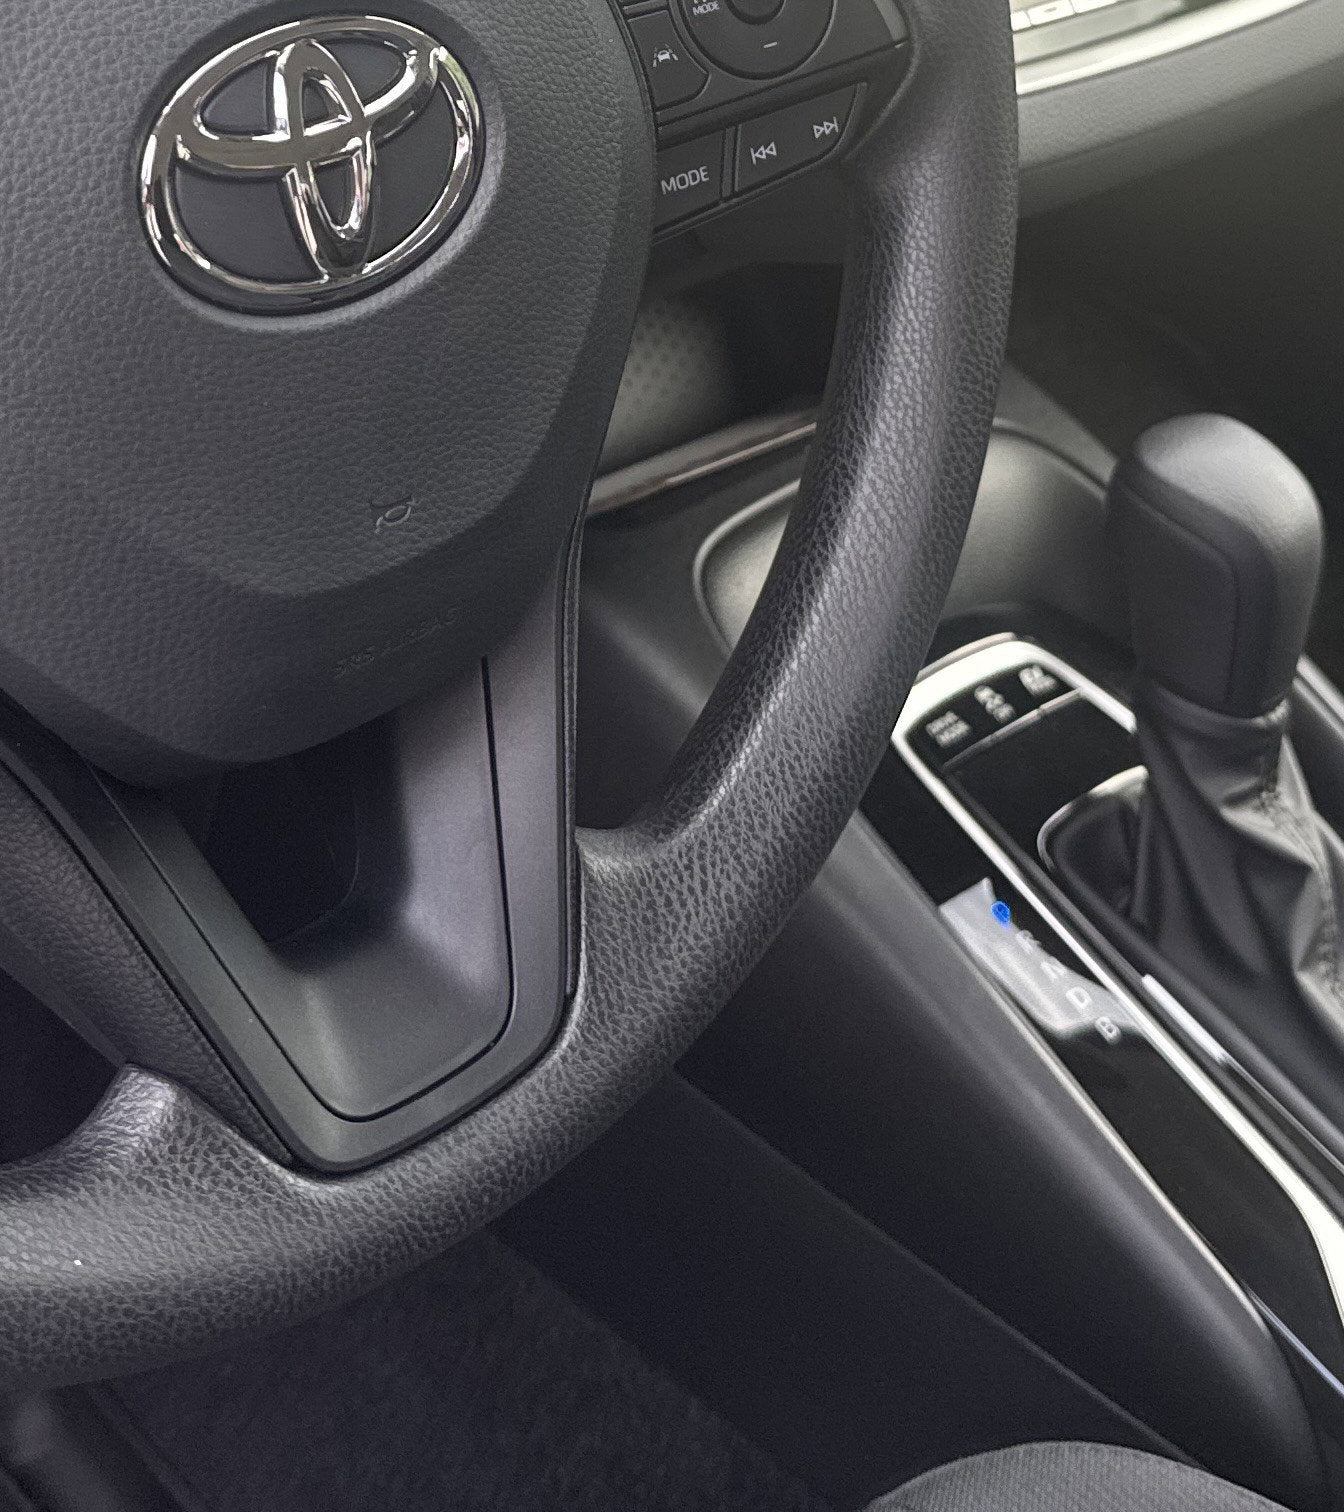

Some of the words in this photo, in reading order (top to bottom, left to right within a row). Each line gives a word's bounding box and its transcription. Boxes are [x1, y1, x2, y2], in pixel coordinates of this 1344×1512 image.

[692, 0, 721, 16] MODE
[661, 165, 710, 196] MODE
[1065, 987, 1092, 1010] D
[1094, 1015, 1122, 1045] B
